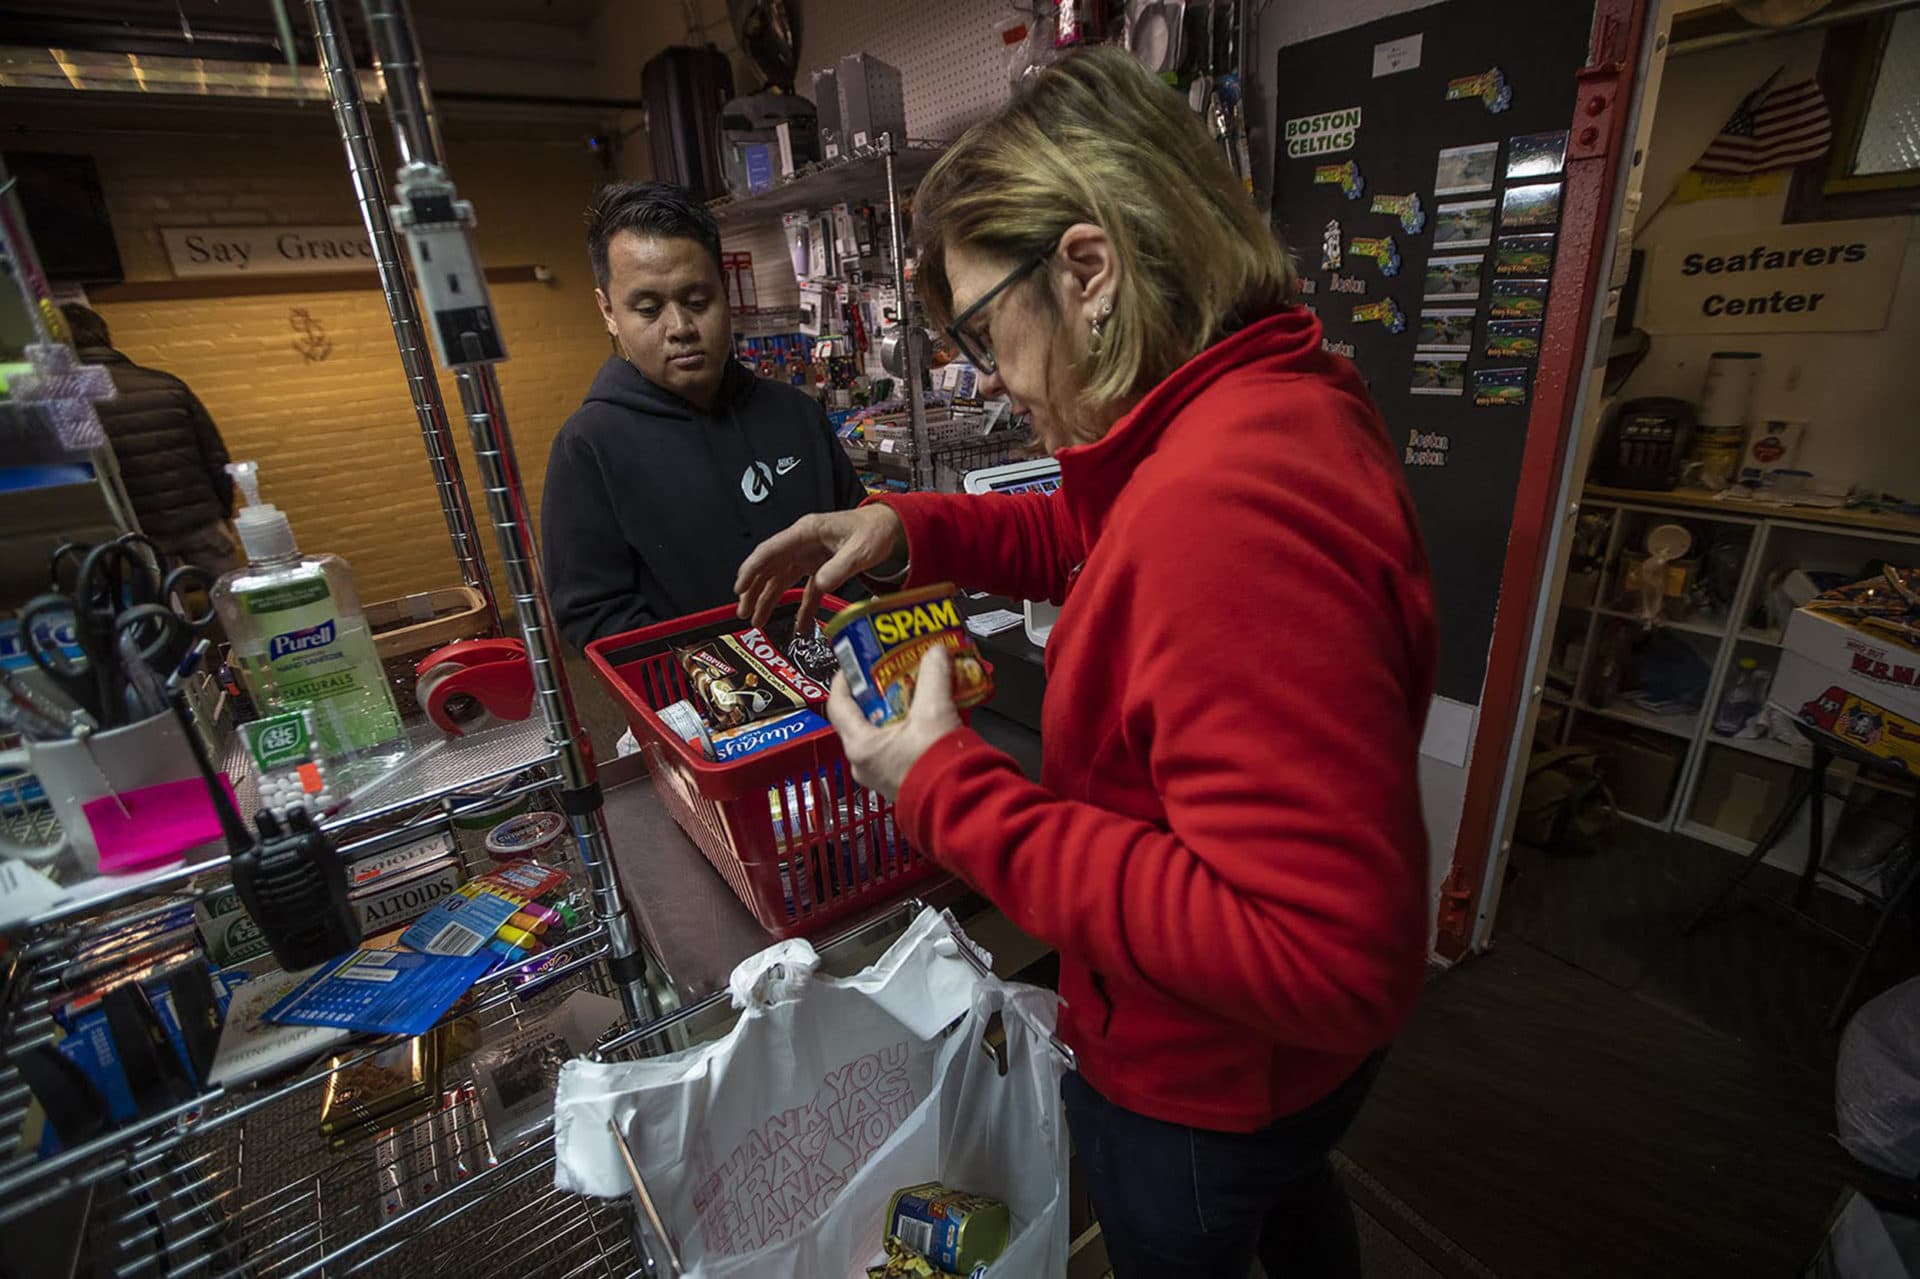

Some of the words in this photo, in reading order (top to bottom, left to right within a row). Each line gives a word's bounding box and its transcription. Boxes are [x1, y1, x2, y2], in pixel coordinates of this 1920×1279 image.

[1287, 109, 1359, 138] BOSTON
[1289, 131, 1354, 156] CELTICS
[185, 235, 252, 269] Say
[277, 233, 372, 260] Grace
[1681, 242, 1867, 276] Seafarers
[1702, 290, 1825, 317] Center
[777, 456, 795, 468] NIKE
[874, 598, 961, 645] SPAM
[274, 625, 332, 655] Purell
[699, 650, 732, 673] KOPIKO
[740, 628, 823, 700] KOPIKO
[282, 673, 353, 697] NATURALS
[266, 736, 294, 750] tac
[271, 727, 294, 739] tic
[716, 721, 805, 761] always
[365, 877, 453, 923] ALTOIDS
[823, 1040, 910, 1100] YOU
